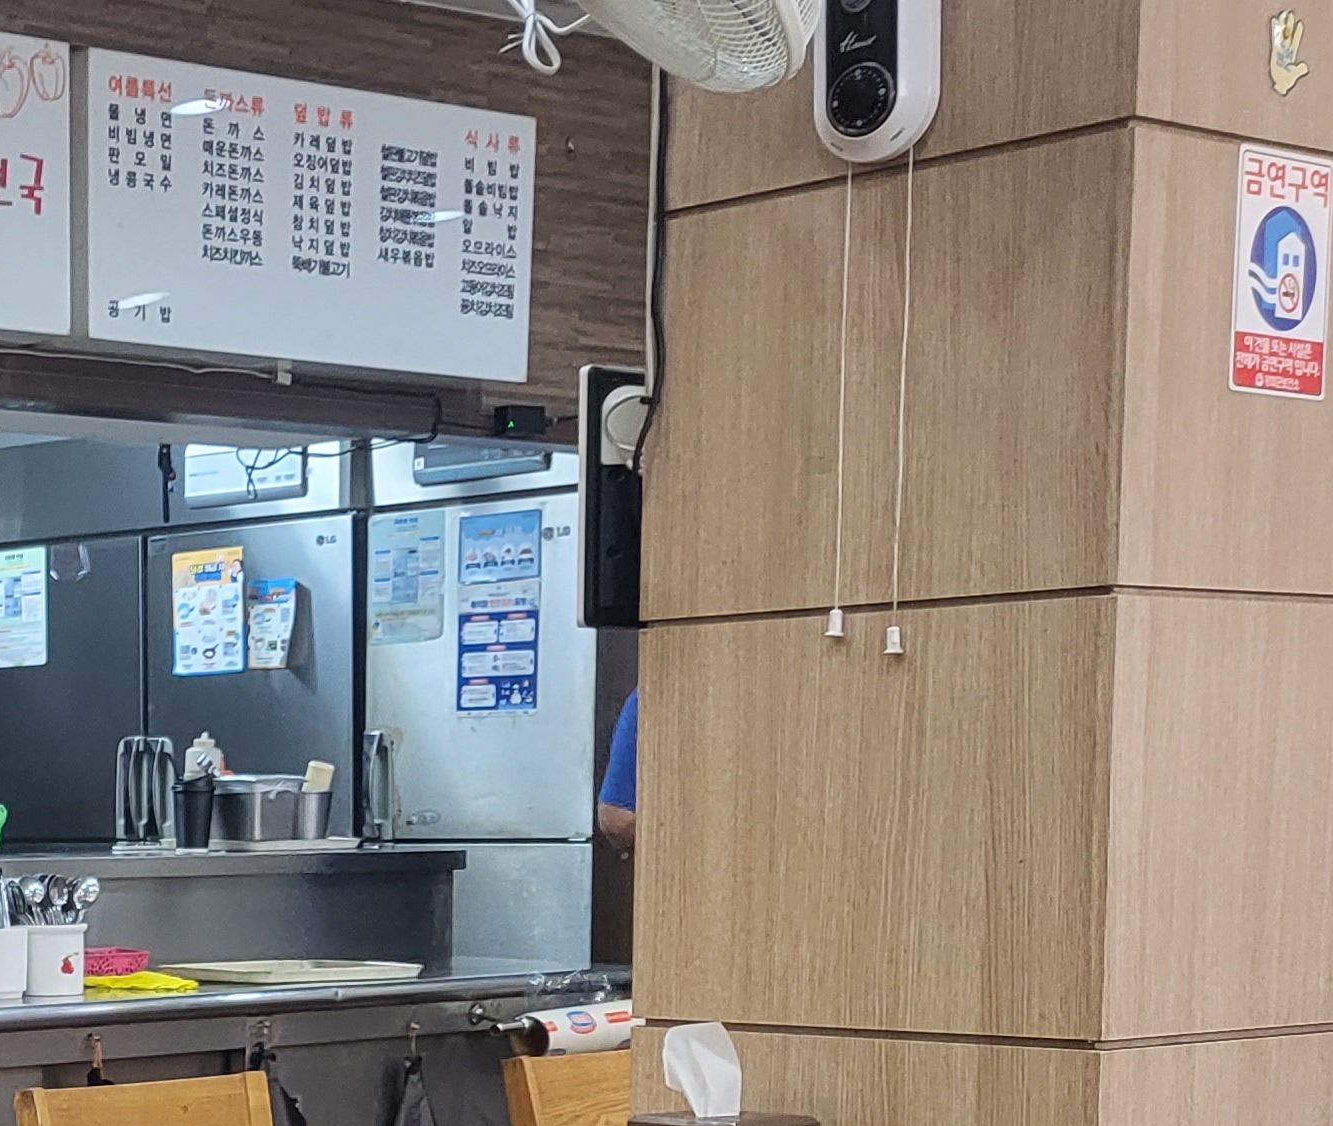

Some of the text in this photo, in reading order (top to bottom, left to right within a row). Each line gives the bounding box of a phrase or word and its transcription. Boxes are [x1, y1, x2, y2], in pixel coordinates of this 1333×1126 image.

[108, 103, 172, 128] 물냉면
[293, 103, 354, 129] 덮밥류
[108, 125, 172, 150] 비빔냉면
[202, 117, 266, 142] 돈까스
[465, 129, 521, 153] 식사류
[202, 140, 265, 163] 매운돈까스
[293, 131, 353, 155] 카레덮밥
[202, 160, 265, 183] 치즈돈까스
[293, 153, 353, 176] 오징어덮밥
[465, 157, 519, 179] 비빔밥
[202, 181, 264, 204] 카레돈까스
[293, 173, 352, 196] 김치덮밥
[1244, 157, 1329, 208] 금연구역
[293, 194, 352, 217] 제육덮밥
[202, 223, 263, 247] 돈까스우동
[292, 215, 351, 237] 참치덮밥
[292, 235, 351, 258] 낙지덮밥
[107, 300, 172, 324] 공기밥
[557, 526, 571, 537] LG
